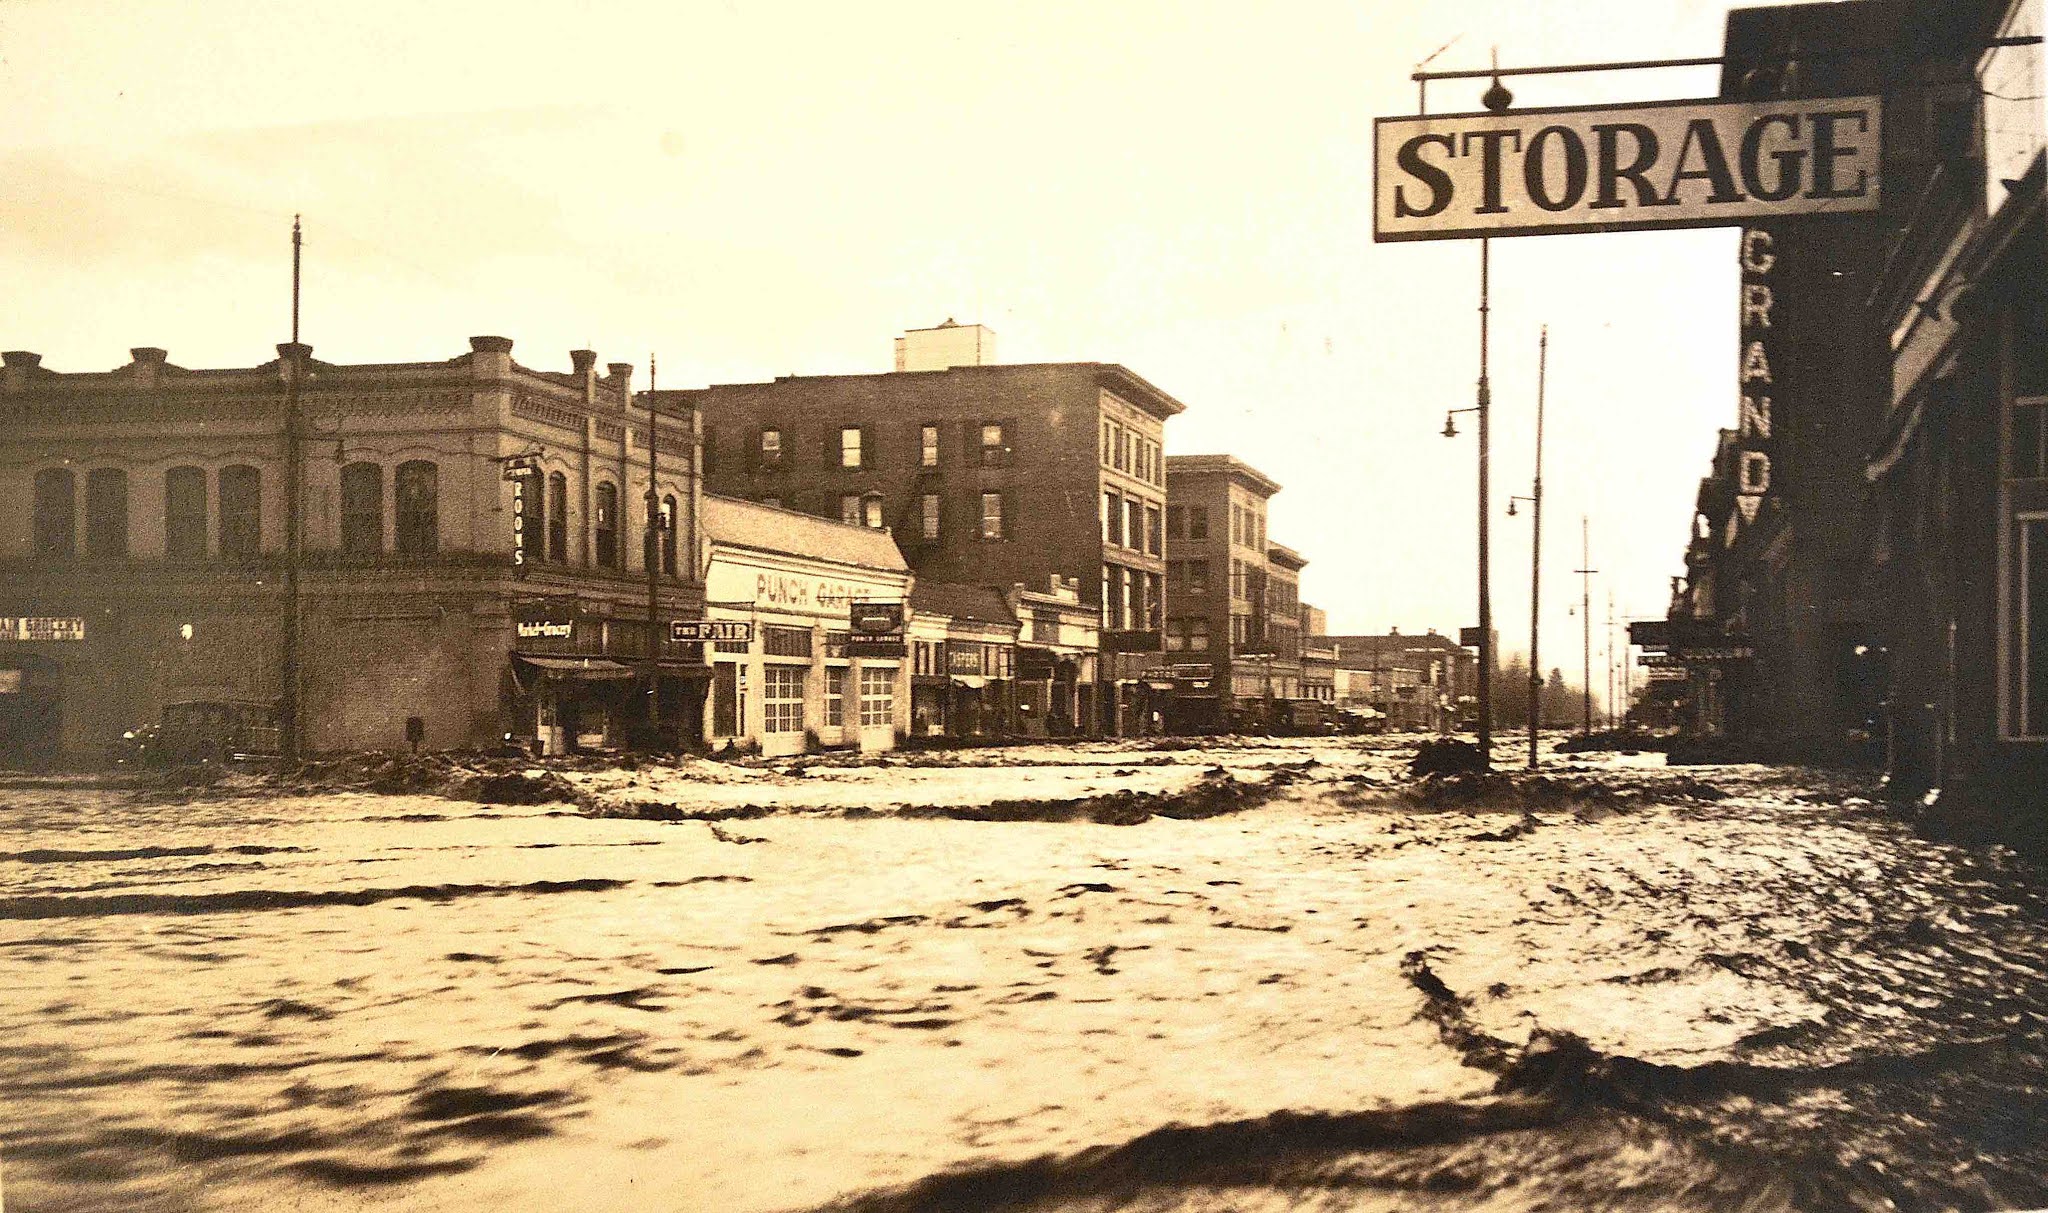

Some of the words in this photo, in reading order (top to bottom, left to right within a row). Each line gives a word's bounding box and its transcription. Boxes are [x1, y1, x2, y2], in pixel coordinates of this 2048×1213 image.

[1394, 109, 1869, 218] STORAGE
[1740, 228, 1776, 494] GRAND
[514, 481, 523, 565] ROOMS
[756, 573, 809, 605] PUNCH
[675, 626, 696, 637] THE
[699, 623, 749, 640] FAIR
